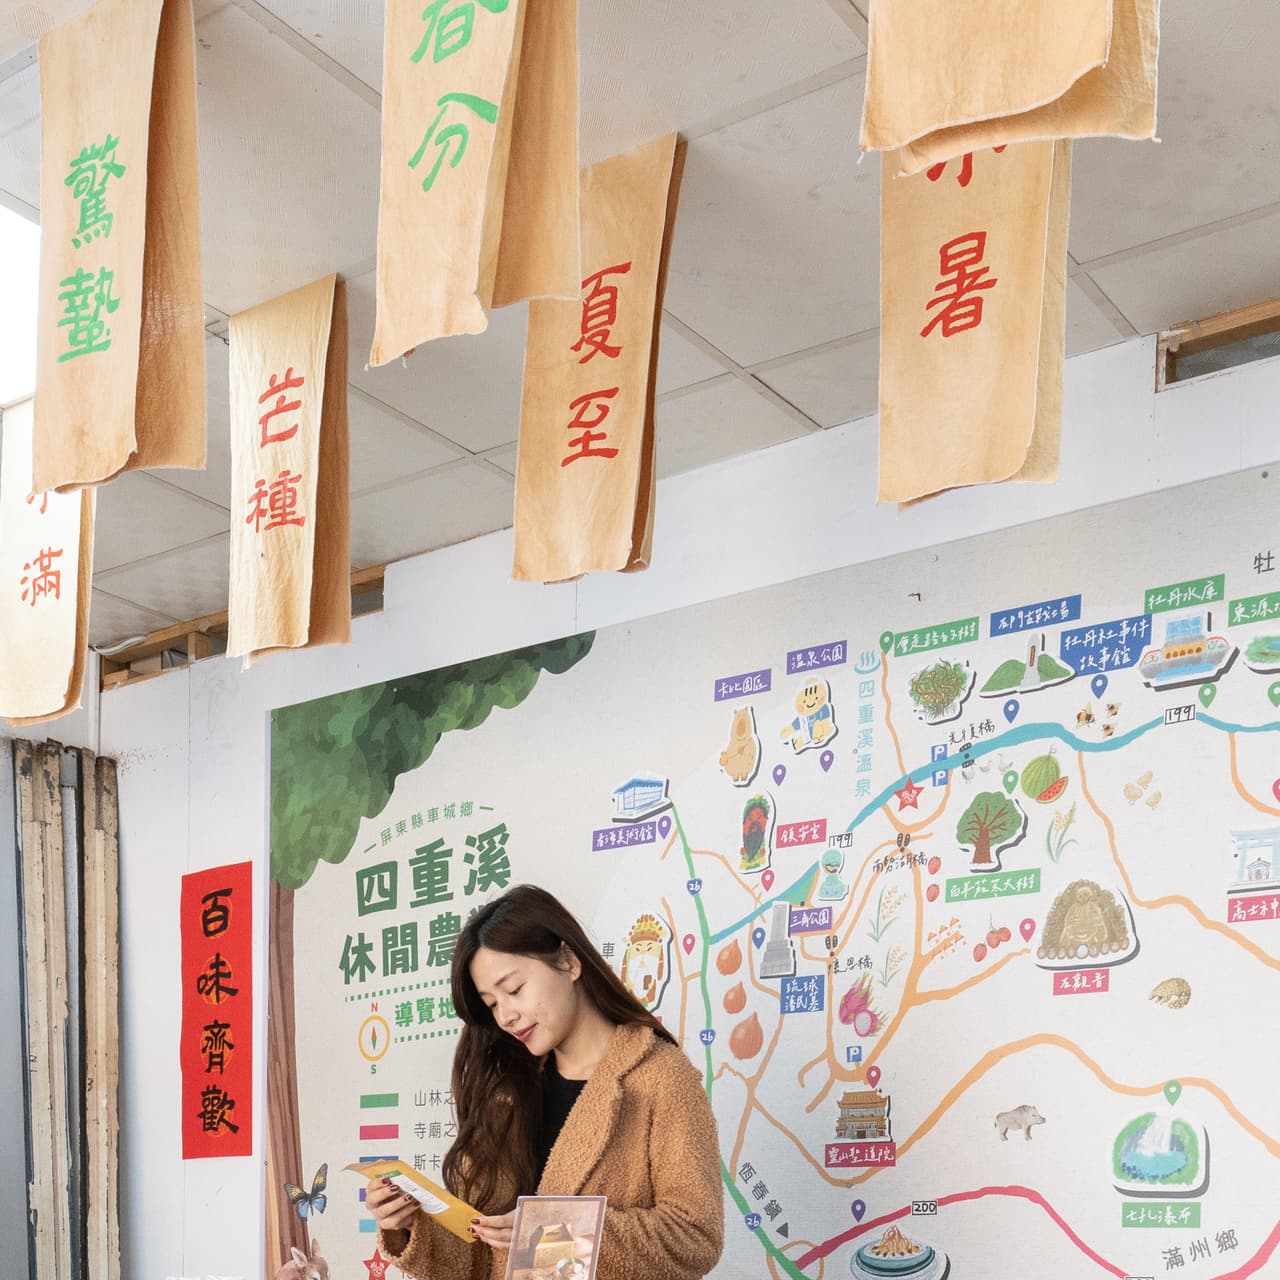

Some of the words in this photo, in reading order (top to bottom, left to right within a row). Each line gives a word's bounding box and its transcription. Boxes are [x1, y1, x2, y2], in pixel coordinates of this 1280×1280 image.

[56, 132, 126, 365] 驚蟄
[560, 261, 632, 468] 夏至
[246, 366, 306, 534] 芒種
[1148, 580, 1218, 609] 牡丹水庫
[1065, 618, 1150, 651] 牡丹社事件
[791, 644, 844, 670] 溫泉公園
[1080, 646, 1132, 671] 故事館
[1167, 706, 1194, 722] 199
[855, 679, 876, 797] 四重溪溫泉
[934, 746, 944, 757] P
[935, 771, 945, 782] P
[380, 800, 475, 848] 屏東縣車城鄉
[780, 823, 821, 846] 鎮安宮
[355, 822, 513, 918] 四重溪
[688, 881, 701, 893] 26
[791, 909, 830, 928] 三角公園
[338, 906, 483, 986] 休閒農
[601, 942, 616, 959] 車
[786, 975, 819, 993] 琉球
[1060, 971, 1107, 991] 石觀音
[196, 887, 239, 1136] 百味齊歡
[370, 1002, 379, 1014] N
[702, 1032, 714, 1043] 26
[849, 1048, 860, 1061] P
[370, 1064, 377, 1075] S
[738, 1161, 783, 1222] 恆春鎮
[913, 1201, 937, 1215] 200
[1125, 1206, 1194, 1225] 七孔瀑布
[746, 1215, 761, 1228] 26
[1161, 1228, 1240, 1271] 滿州鄉
